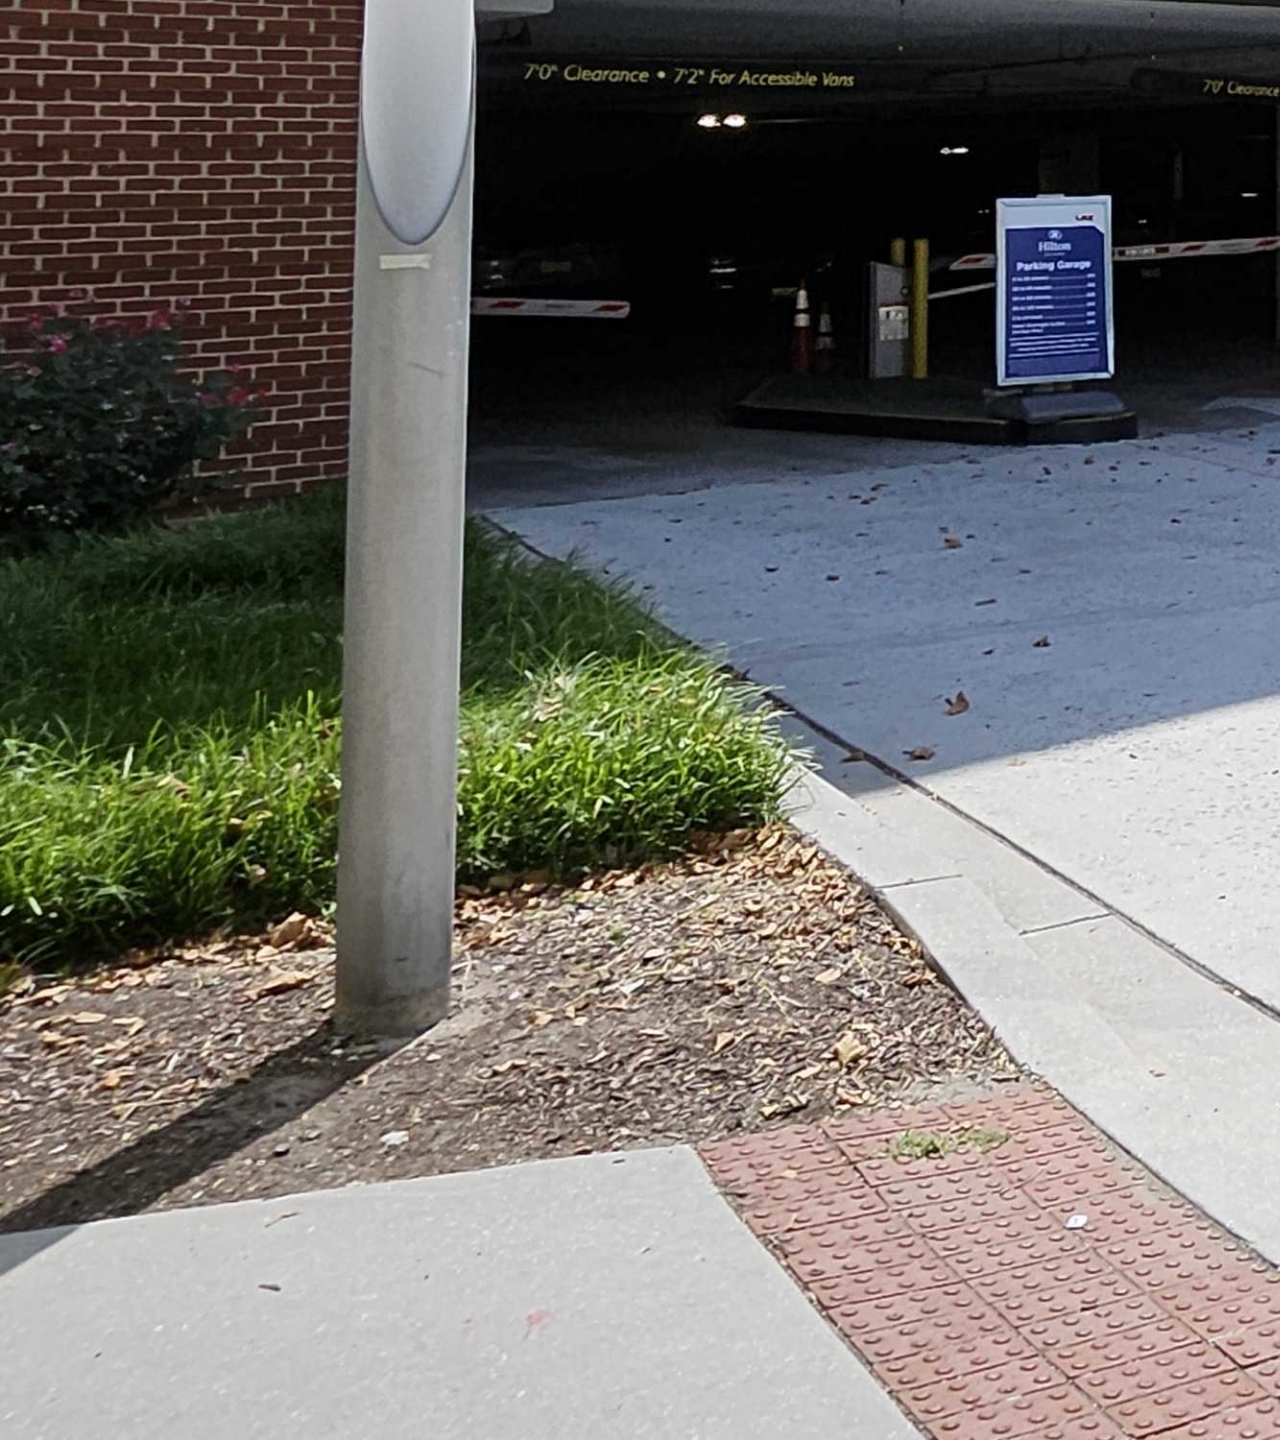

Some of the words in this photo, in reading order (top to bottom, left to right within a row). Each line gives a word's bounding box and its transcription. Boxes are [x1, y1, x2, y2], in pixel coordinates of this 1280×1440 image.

[563, 63, 651, 84] Clearance
[709, 71, 736, 87] For
[738, 70, 817, 89] Accessible
[821, 72, 855, 88] Vans
[1227, 80, 1280, 98] Clearance
[1016, 261, 1055, 272] Parking
[1057, 260, 1092, 270] Garage
